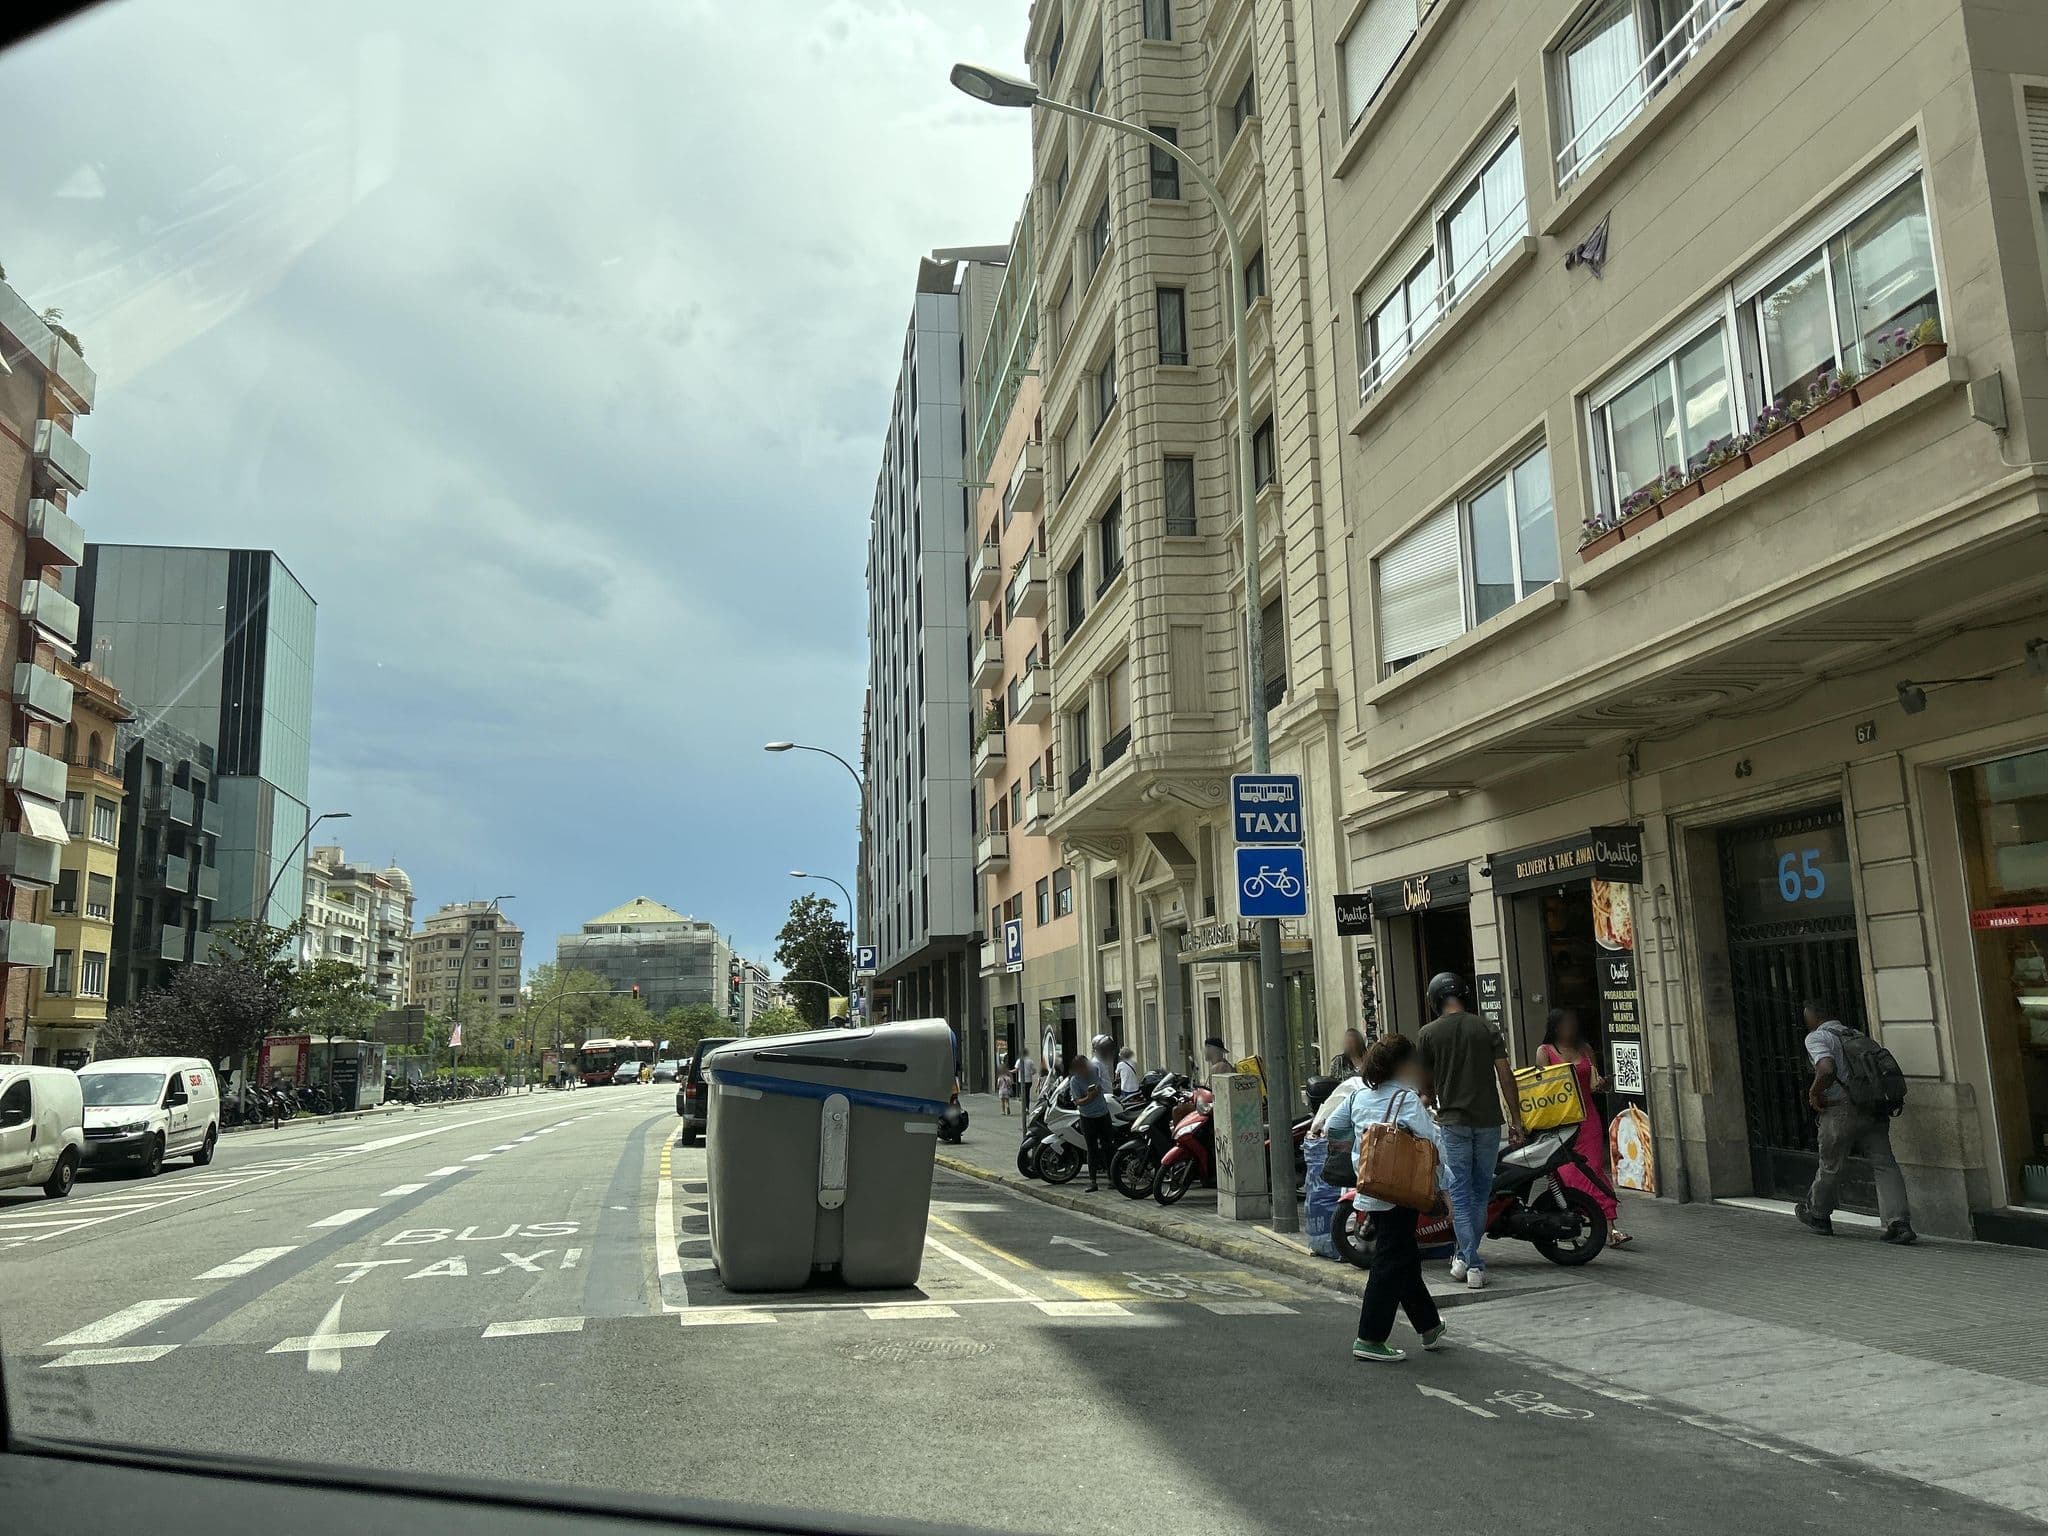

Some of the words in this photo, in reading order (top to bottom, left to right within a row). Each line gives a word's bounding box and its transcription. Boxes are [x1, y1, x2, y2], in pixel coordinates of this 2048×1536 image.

[1857, 726, 1872, 742] 67
[1735, 759, 1753, 779] 65
[1240, 812, 1297, 833] TAXI
[1595, 840, 1637, 866] Chalito
[1516, 857, 1547, 878] DELIVERY
[1548, 855, 1555, 871] &
[1555, 851, 1574, 869] TAKE
[1777, 848, 1825, 902] 65
[1403, 875, 1431, 911] Chalito
[1337, 905, 1368, 923] Chalito
[1990, 917, 2019, 927] REBAJAS
[1008, 925, 1018, 959] P
[860, 948, 873, 967] P
[1608, 1023, 1615, 1033] DE
[1520, 1092, 1568, 1113] Glovo
[381, 1221, 581, 1246] BUS
[334, 1247, 583, 1285] TAXI
